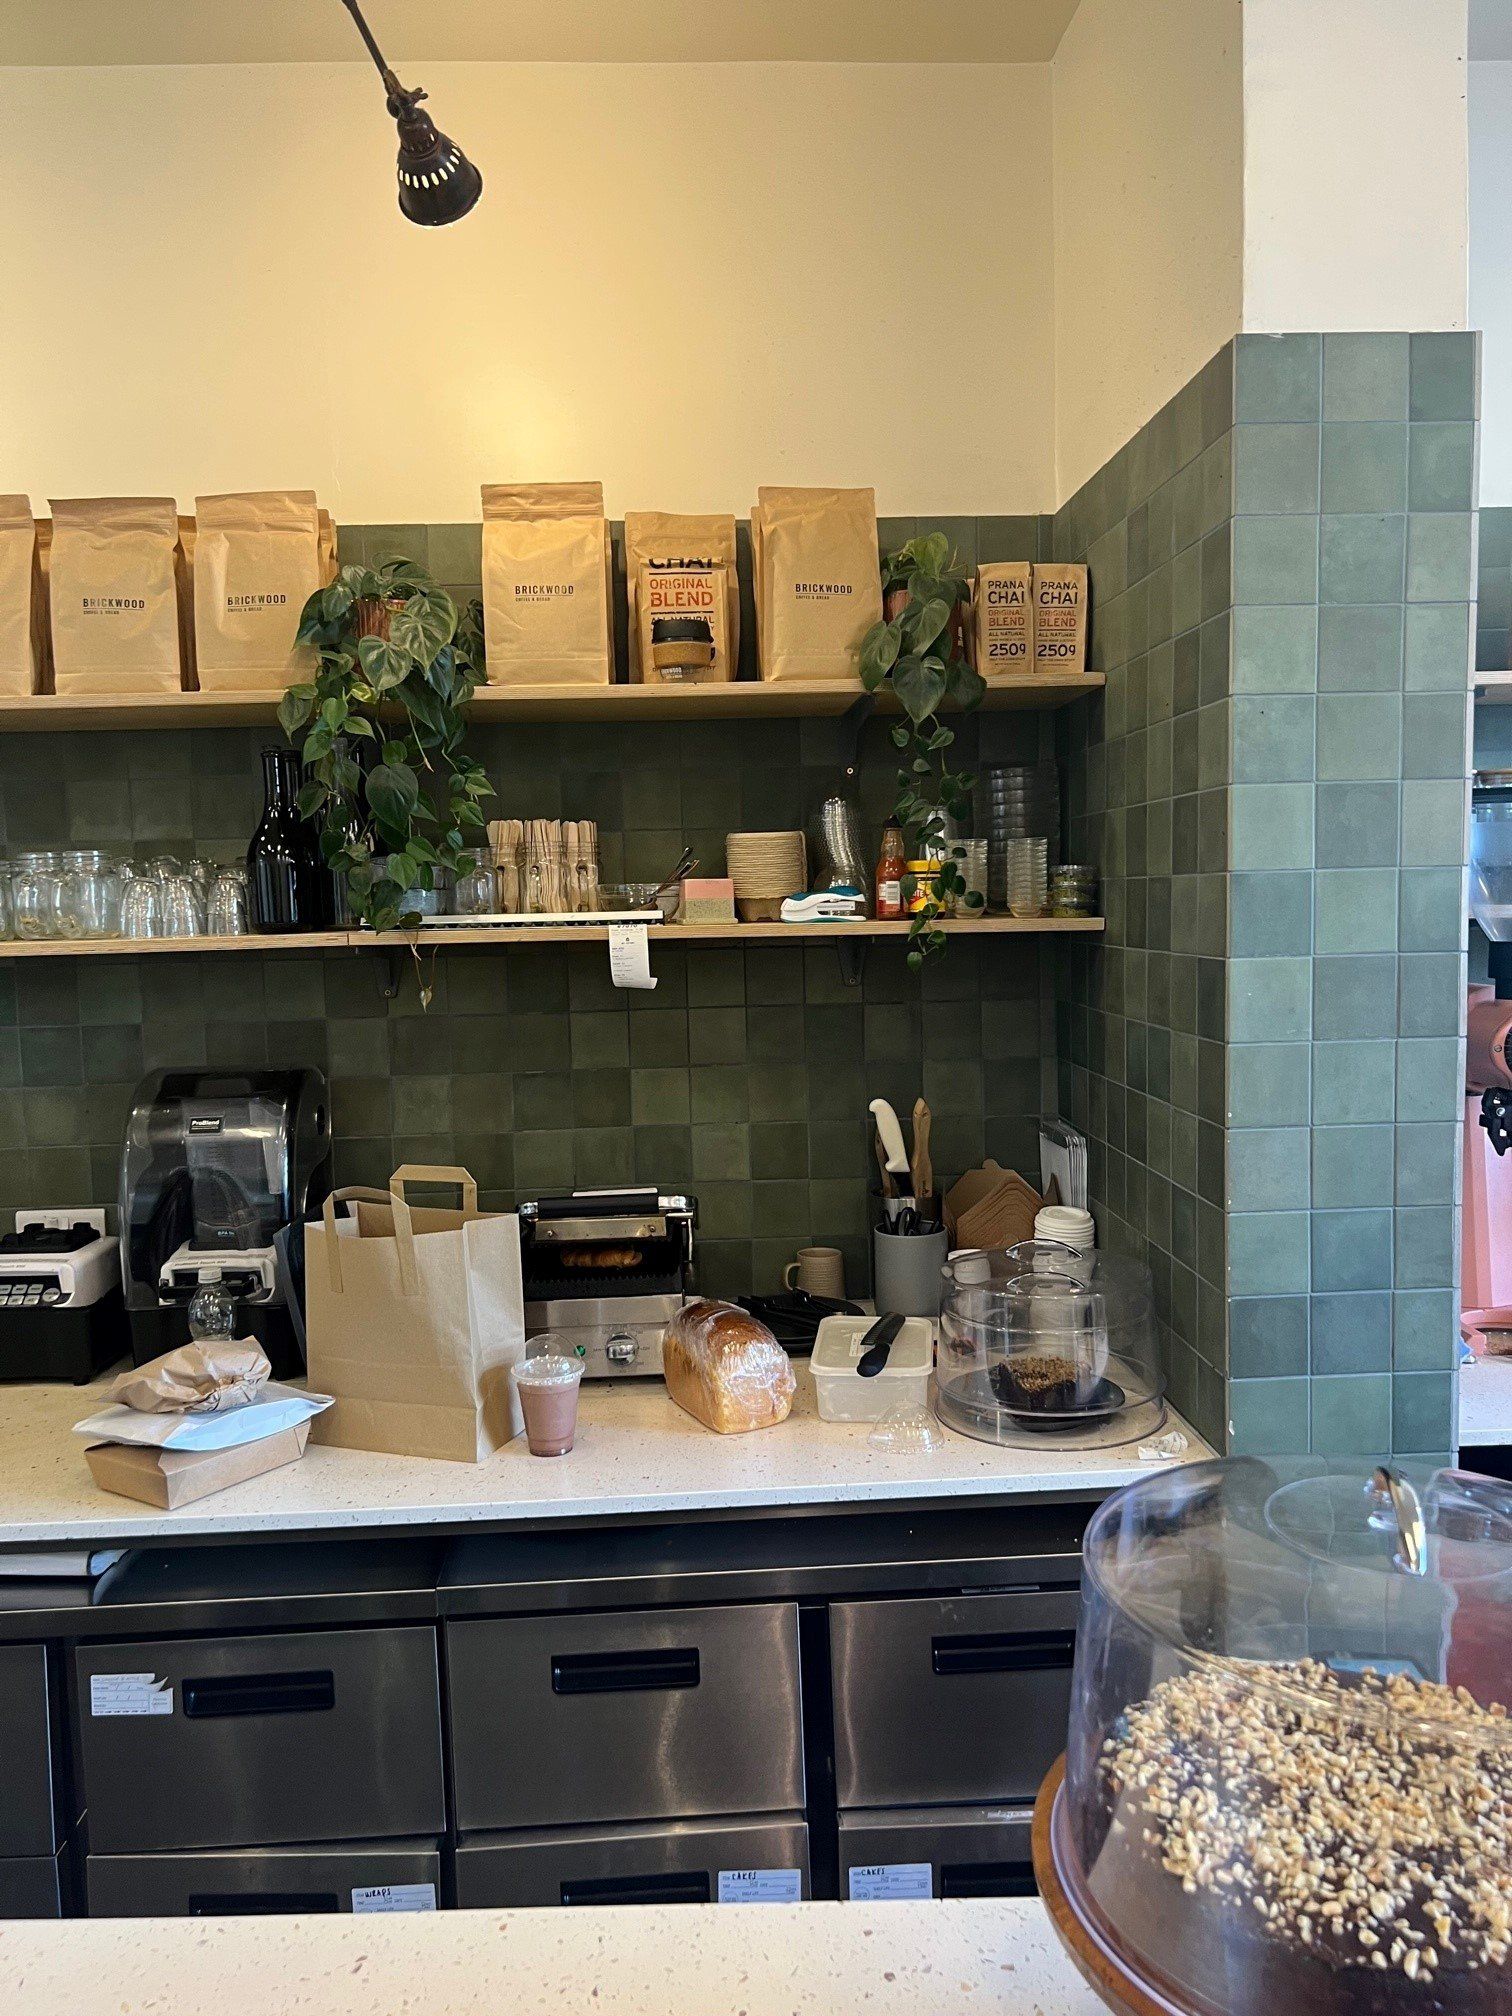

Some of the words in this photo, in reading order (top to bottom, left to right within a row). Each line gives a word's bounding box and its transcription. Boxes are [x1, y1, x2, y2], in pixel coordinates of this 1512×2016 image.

[650, 578, 712, 589] ORIGINAL
[795, 583, 852, 594] BRICKWOOD
[988, 580, 1024, 589] PRANA
[1040, 582, 1078, 590] PRANA
[515, 585, 574, 594] BRICKWOOD
[227, 594, 286, 606] BRICKWOOD
[650, 592, 714, 607] BLEND
[988, 591, 1024, 604] CHAI
[1040, 592, 1078, 604] CHAI
[83, 598, 145, 608] BRICKWOOD
[988, 617, 1025, 627] BLEND
[1039, 617, 1076, 627] BLEND
[988, 643, 1026, 656] 250g
[1038, 644, 1076, 657] 250g
[732, 1871, 757, 1880] CAKES
[861, 1867, 886, 1876] CAKES
[364, 1888, 391, 1898] WRAPS
